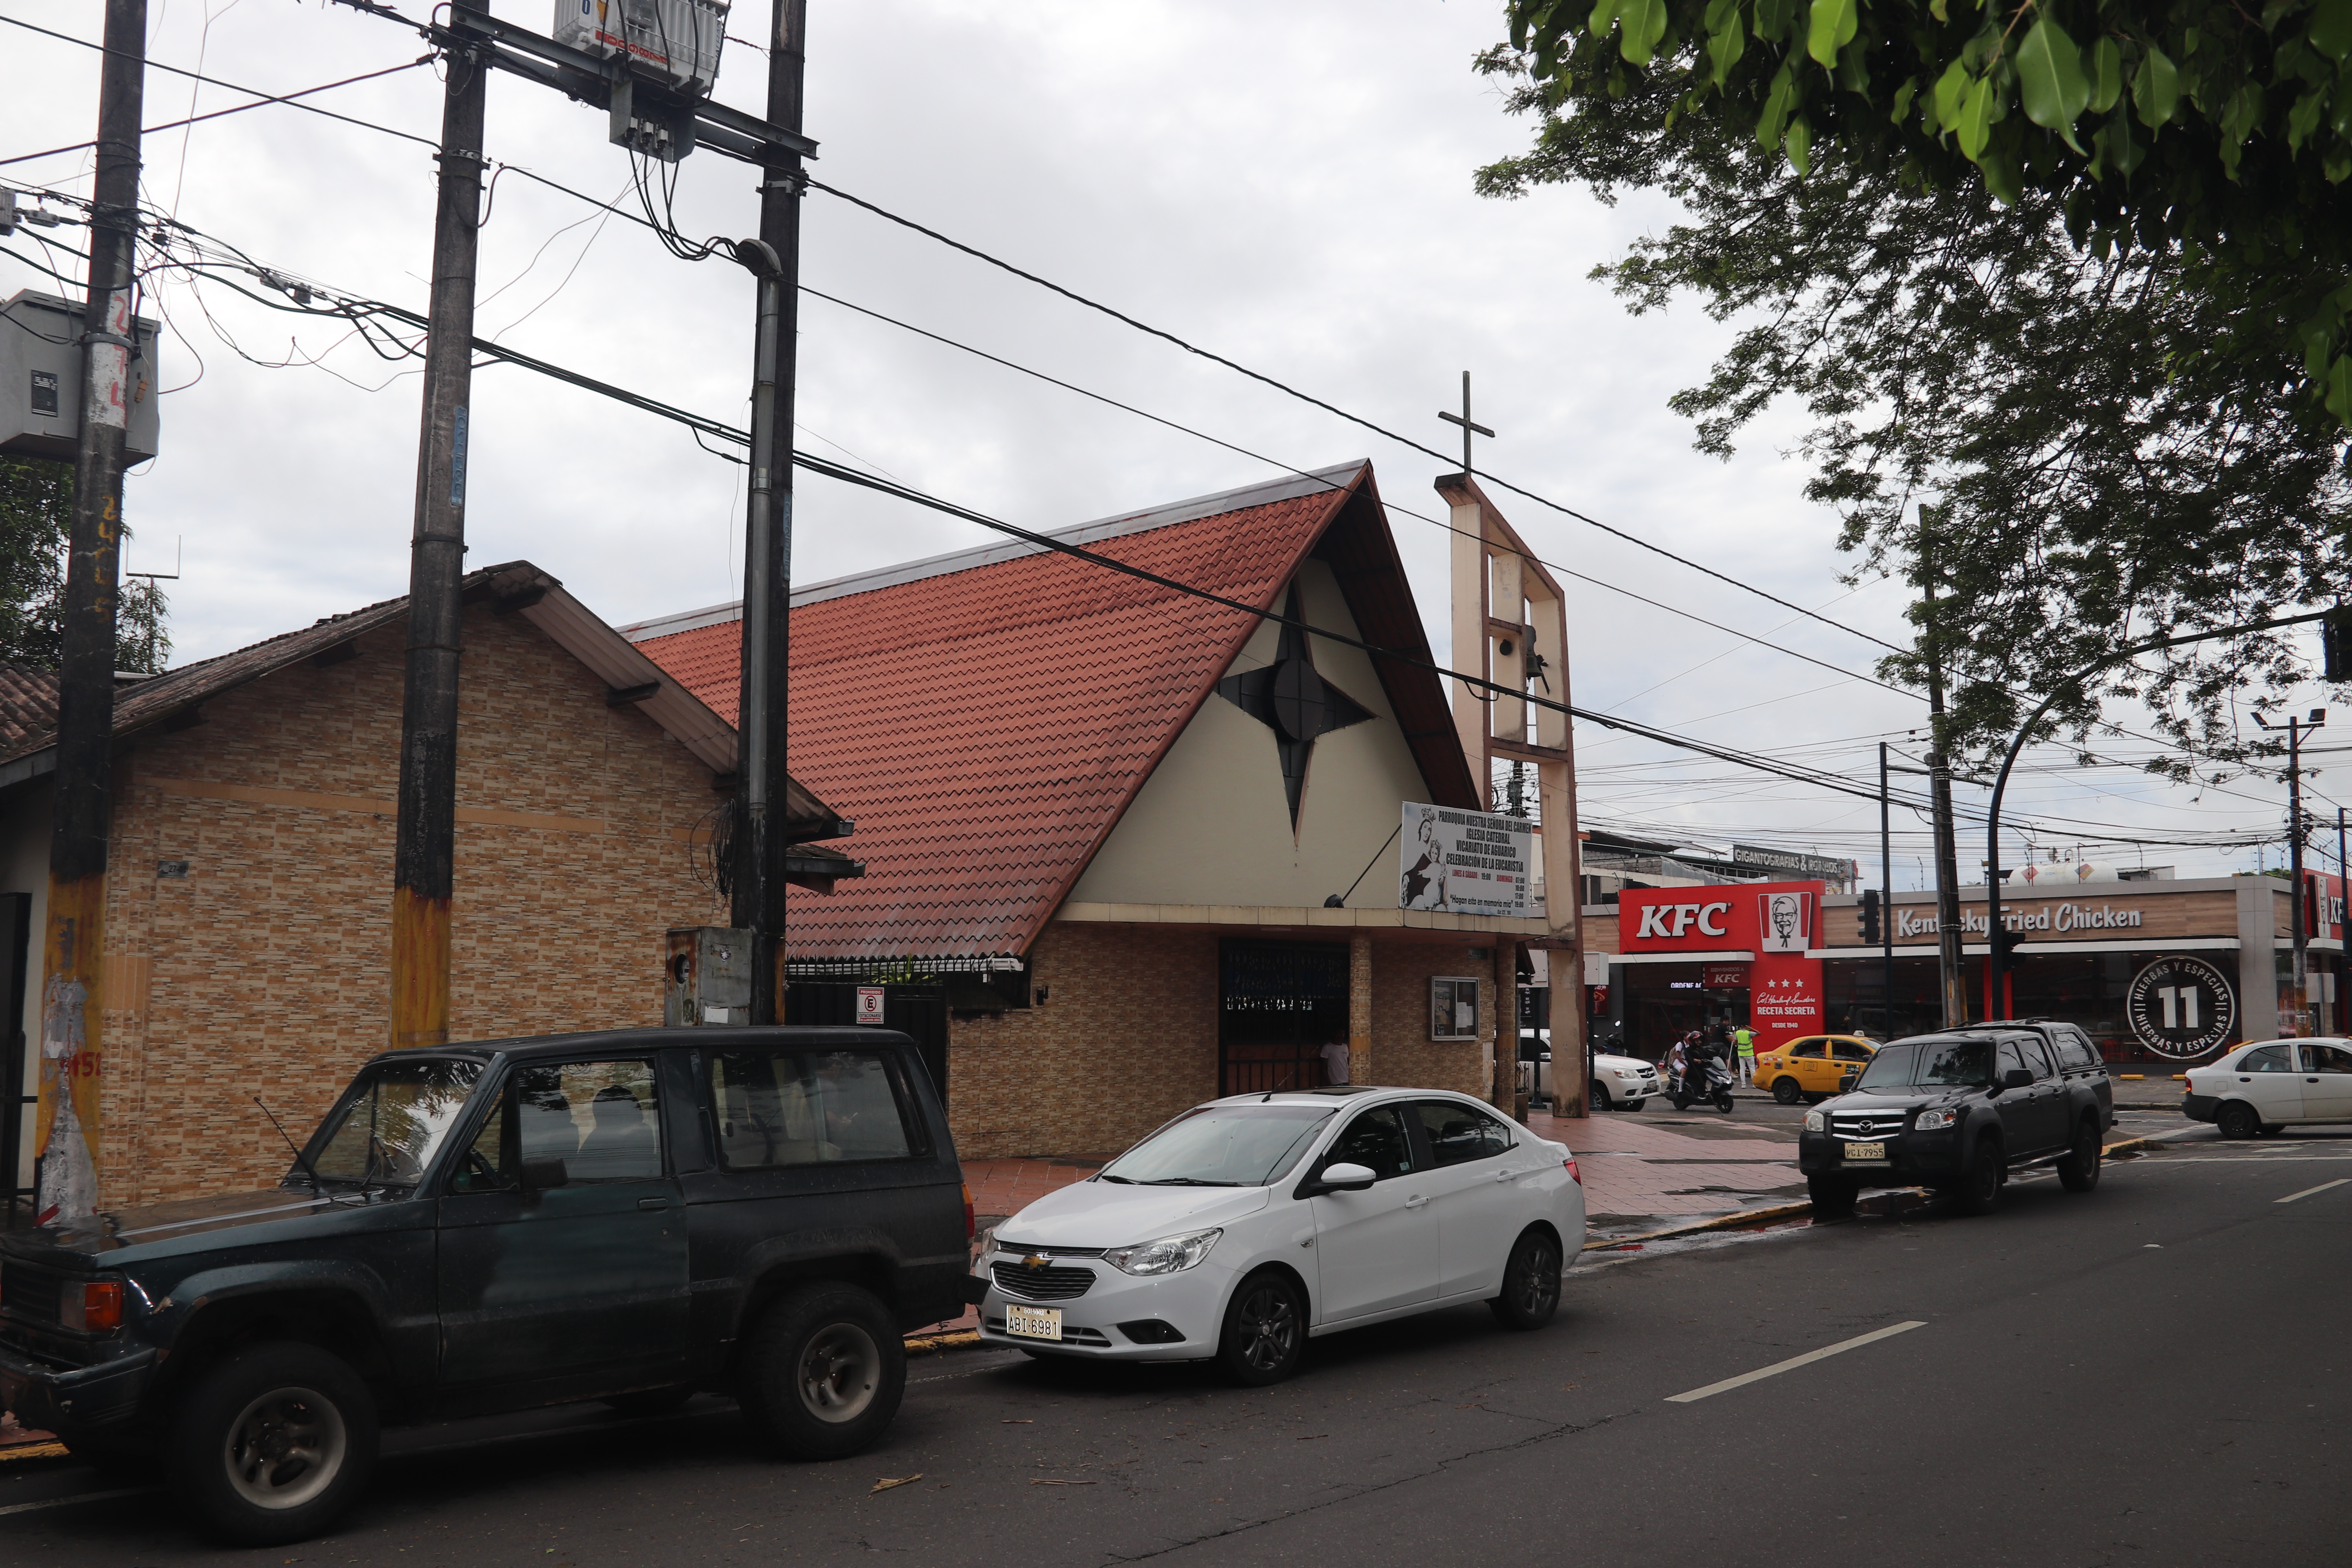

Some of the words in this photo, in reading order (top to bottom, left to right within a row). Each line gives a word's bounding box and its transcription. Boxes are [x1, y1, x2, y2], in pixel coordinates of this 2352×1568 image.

[1439, 810, 1465, 825] PARROQUIA
[1466, 815, 1486, 828] NUESTRA
[1487, 817, 1504, 830] SEÑORA
[1514, 821, 1531, 834] CARMEN
[1466, 828, 1485, 841] IGLESIA
[1486, 831, 1510, 844] CATEDRAL
[1456, 840, 1483, 854] VICARIATO
[1484, 844, 1490, 855] DE
[1491, 845, 1516, 858] AGUARICO
[1446, 853, 1480, 868] CELEBRACIÓN
[1481, 857, 1487, 869] DE
[1488, 858, 1494, 870] LA
[1735, 848, 1799, 869] GIGANTOGRAFIAS
[1800, 855, 1807, 871] &
[1483, 899, 1502, 907] memoria
[2330, 896, 2343, 924] KF
[1636, 902, 1727, 938] KFC
[1898, 909, 1991, 938] Kentcky
[2054, 903, 2141, 932] Chicken
[1714, 974, 1740, 983] KFC
[2134, 964, 2169, 1000] HIERBAS
[2174, 962, 2180, 971] Y
[2185, 963, 2228, 1000] ESPECIAS
[1791, 992, 1815, 1004] Sanders
[2158, 986, 2198, 1028] 11
[1757, 1007, 1783, 1015] RECETA
[1784, 1007, 1815, 1015] SECRETA
[2136, 1014, 2171, 1050] HIERBAS
[2176, 1043, 2182, 1052] Y
[1846, 1148, 1884, 1157] PCI-7955
[1023, 1308, 1044, 1316] ECUADOR
[1009, 1316, 1058, 1336] ABI-6981
